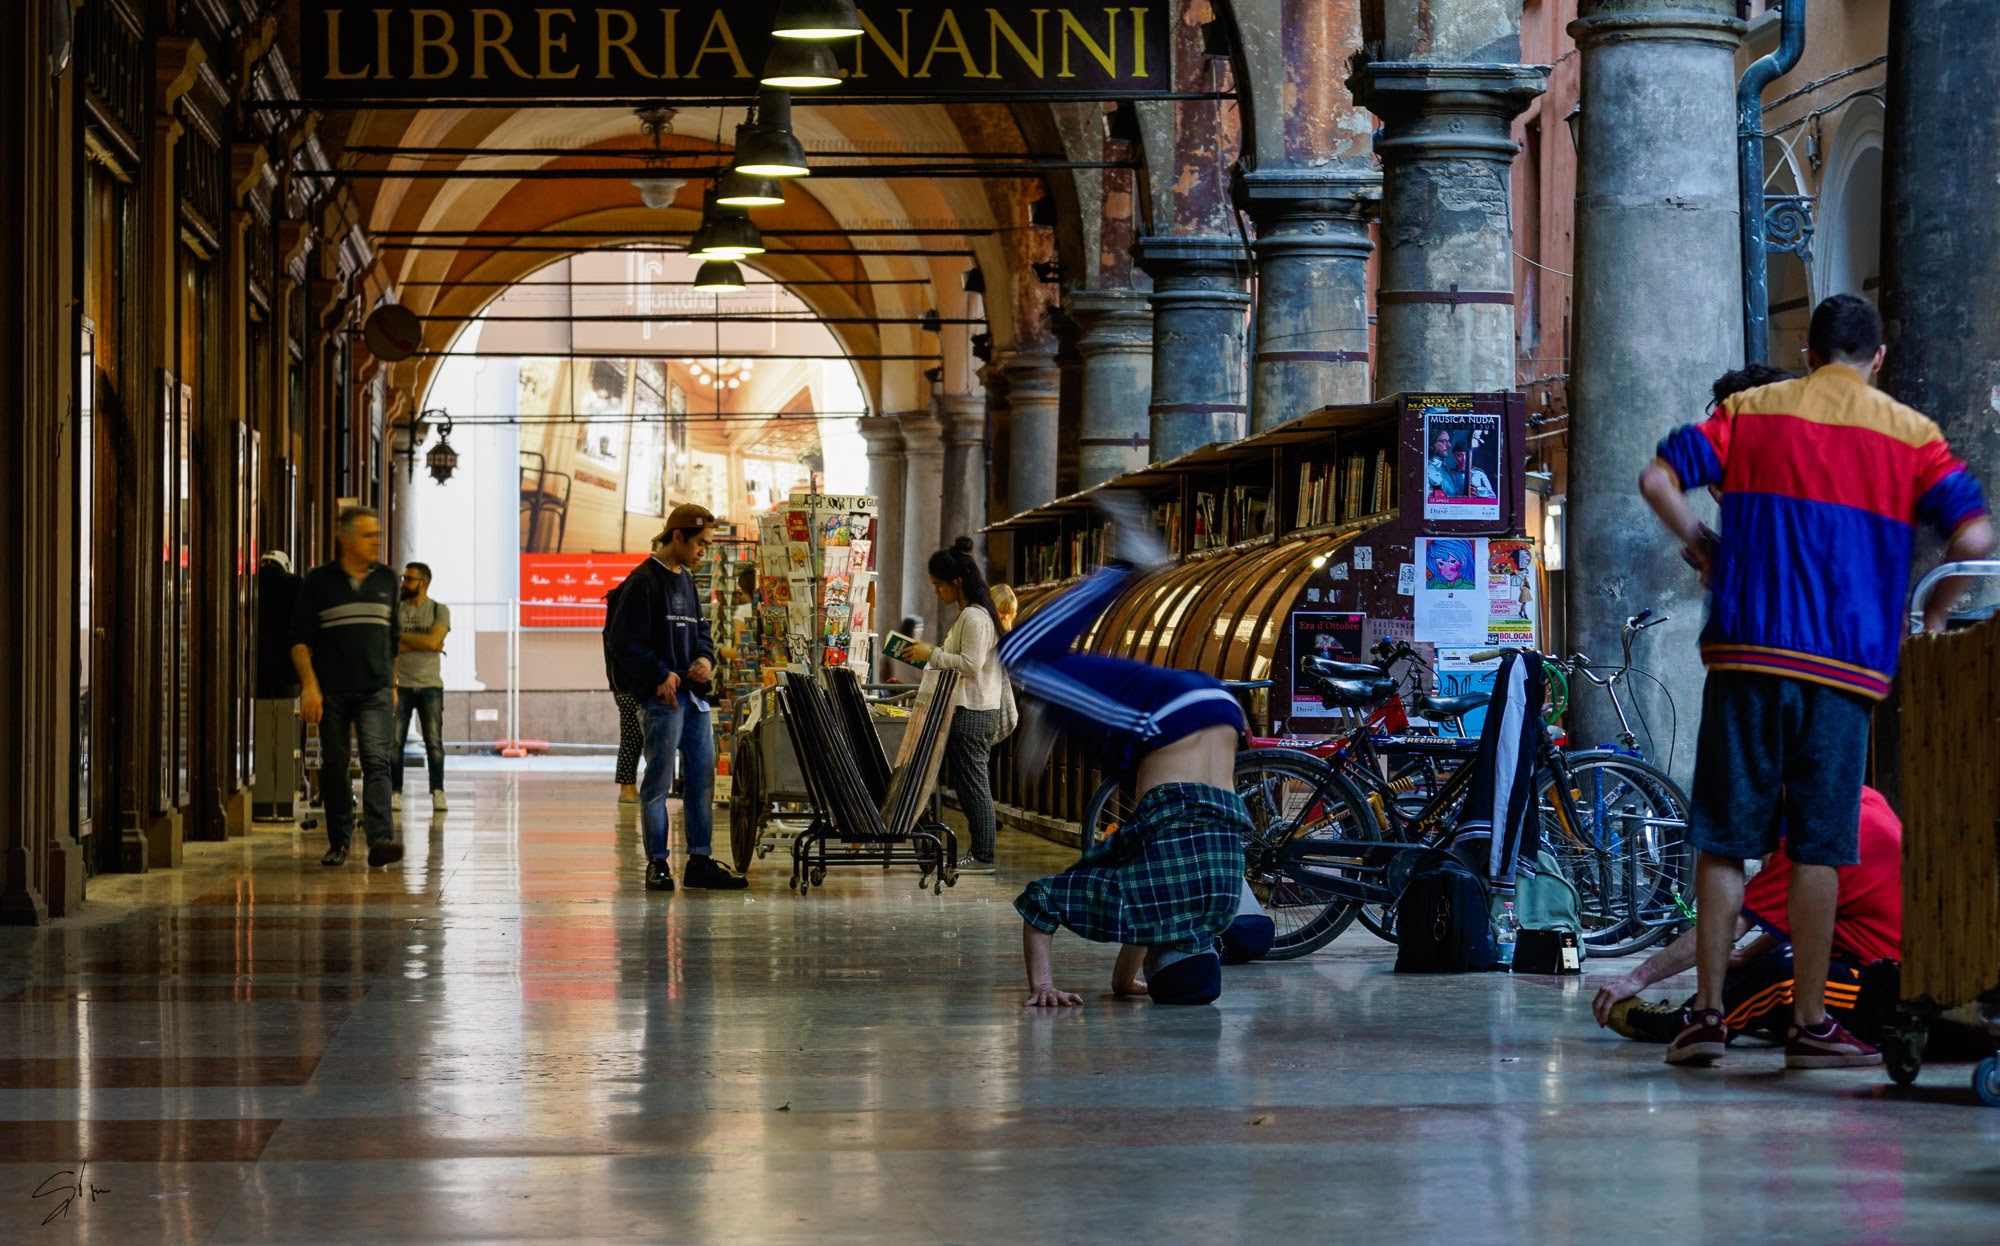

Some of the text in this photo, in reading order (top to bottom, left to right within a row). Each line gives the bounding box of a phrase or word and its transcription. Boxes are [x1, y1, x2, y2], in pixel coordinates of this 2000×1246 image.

[323, 7, 1150, 80] LIBRERIA NANNI
[1430, 415, 1495, 425] MUSICA NUDA
[1299, 620, 1360, 630] Era d'Ottobre
[1499, 632, 1534, 640] BOLOGNA
